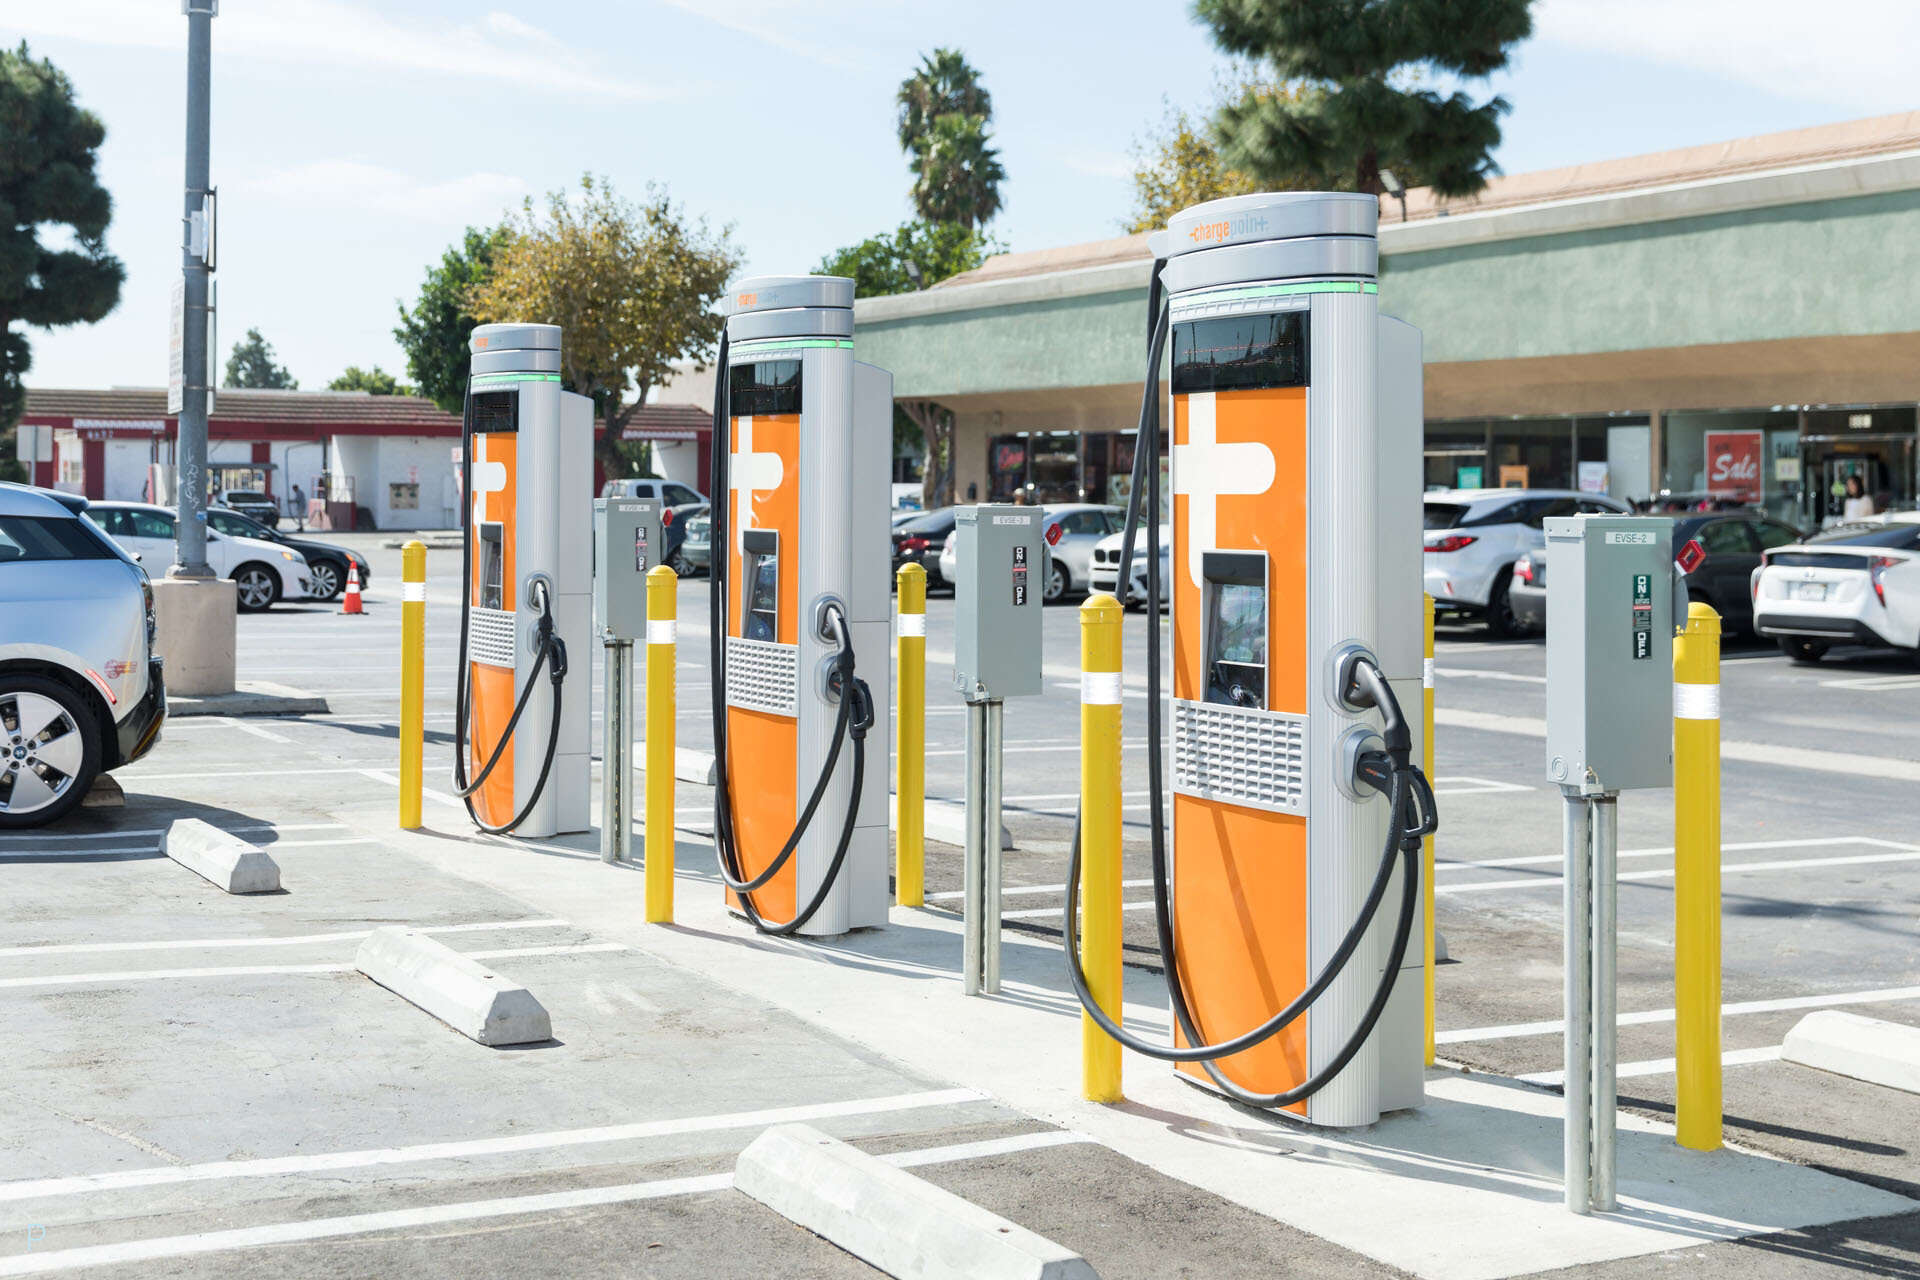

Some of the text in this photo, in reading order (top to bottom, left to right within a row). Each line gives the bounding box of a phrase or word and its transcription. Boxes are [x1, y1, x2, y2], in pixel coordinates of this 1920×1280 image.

[1711, 453, 1758, 482] Sale
[1615, 533, 1648, 544] EVSE-2
[1637, 576, 1647, 594] ON
[1637, 632, 1647, 659] OFF
